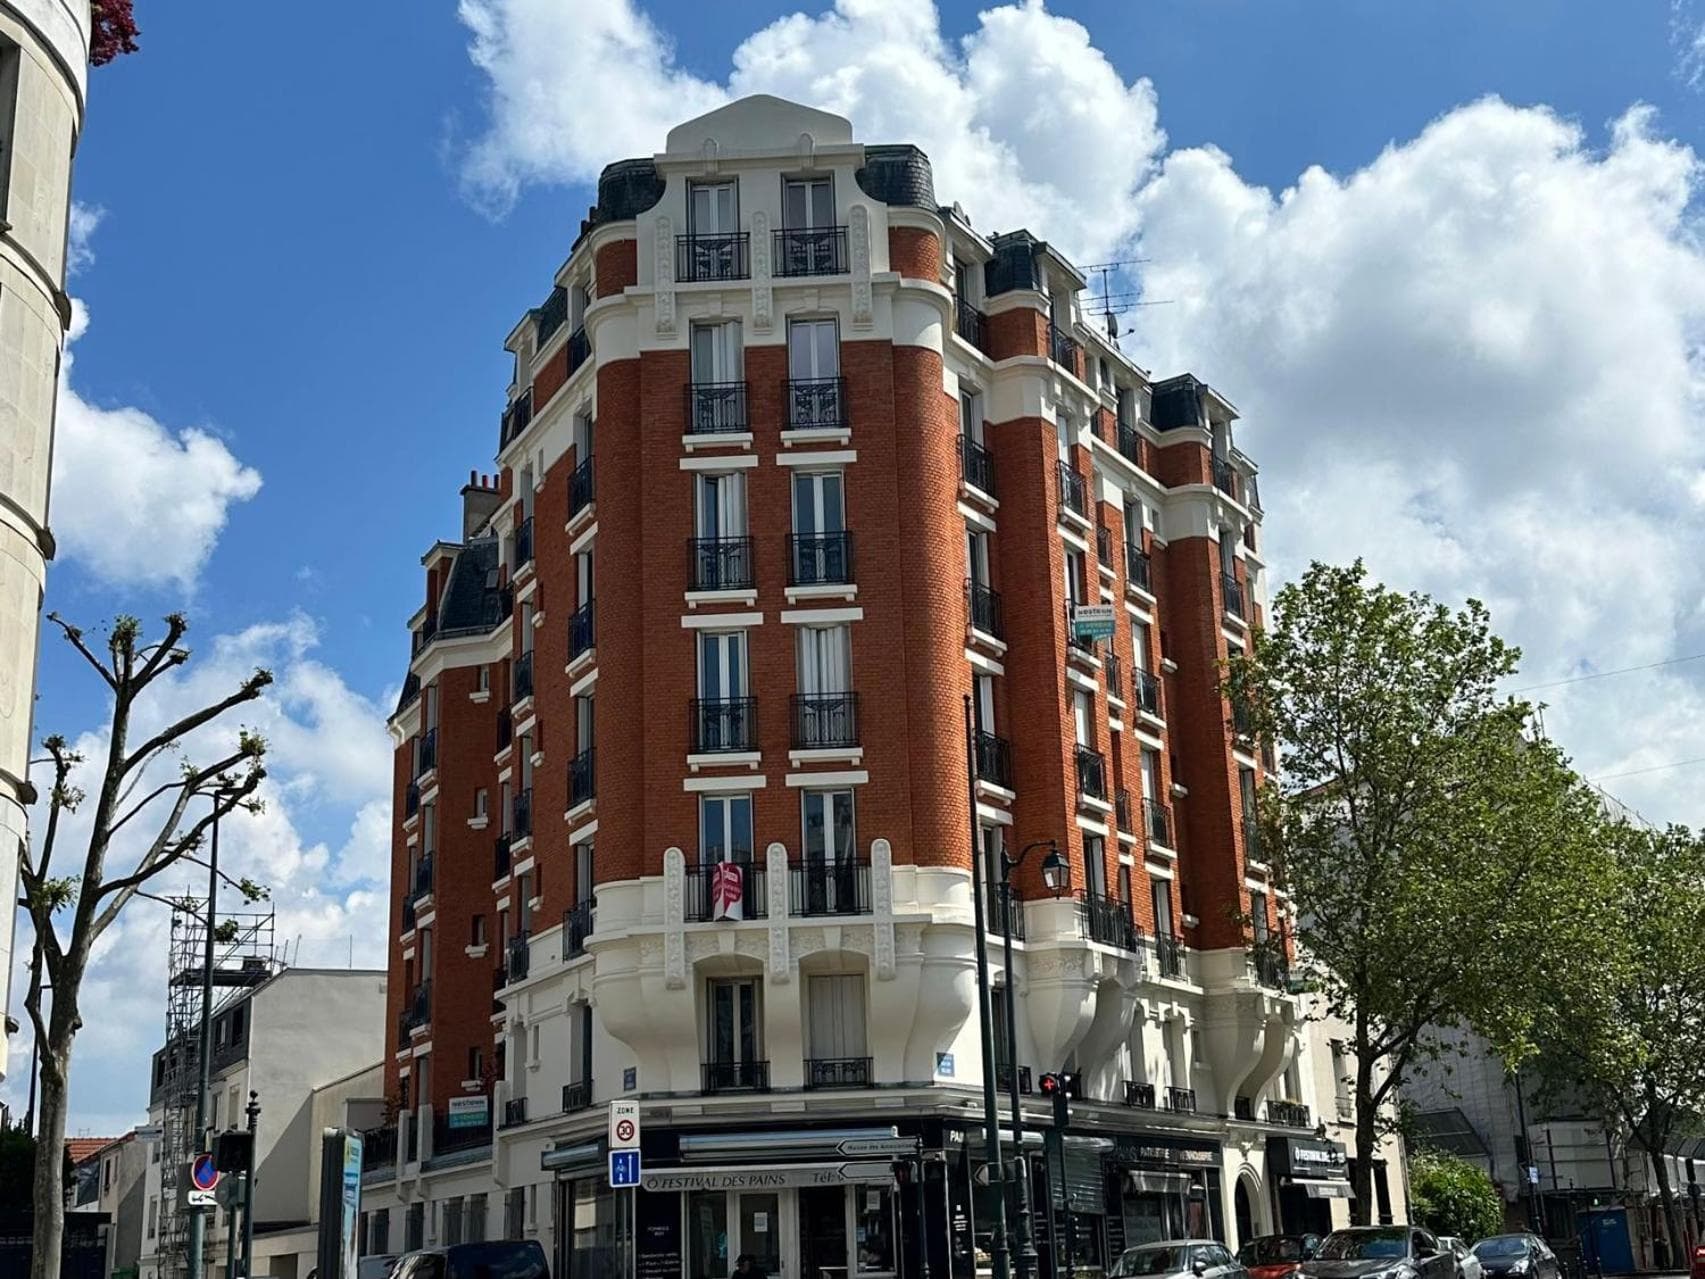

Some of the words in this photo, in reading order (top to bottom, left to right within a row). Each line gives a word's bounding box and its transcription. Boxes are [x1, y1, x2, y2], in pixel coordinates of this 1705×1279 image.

[617, 1106, 635, 1114] ZONE
[620, 1125, 632, 1136] 30
[661, 1177, 718, 1189] FESTIVAL
[722, 1175, 745, 1187] DES
[748, 1174, 786, 1186] PAINS
